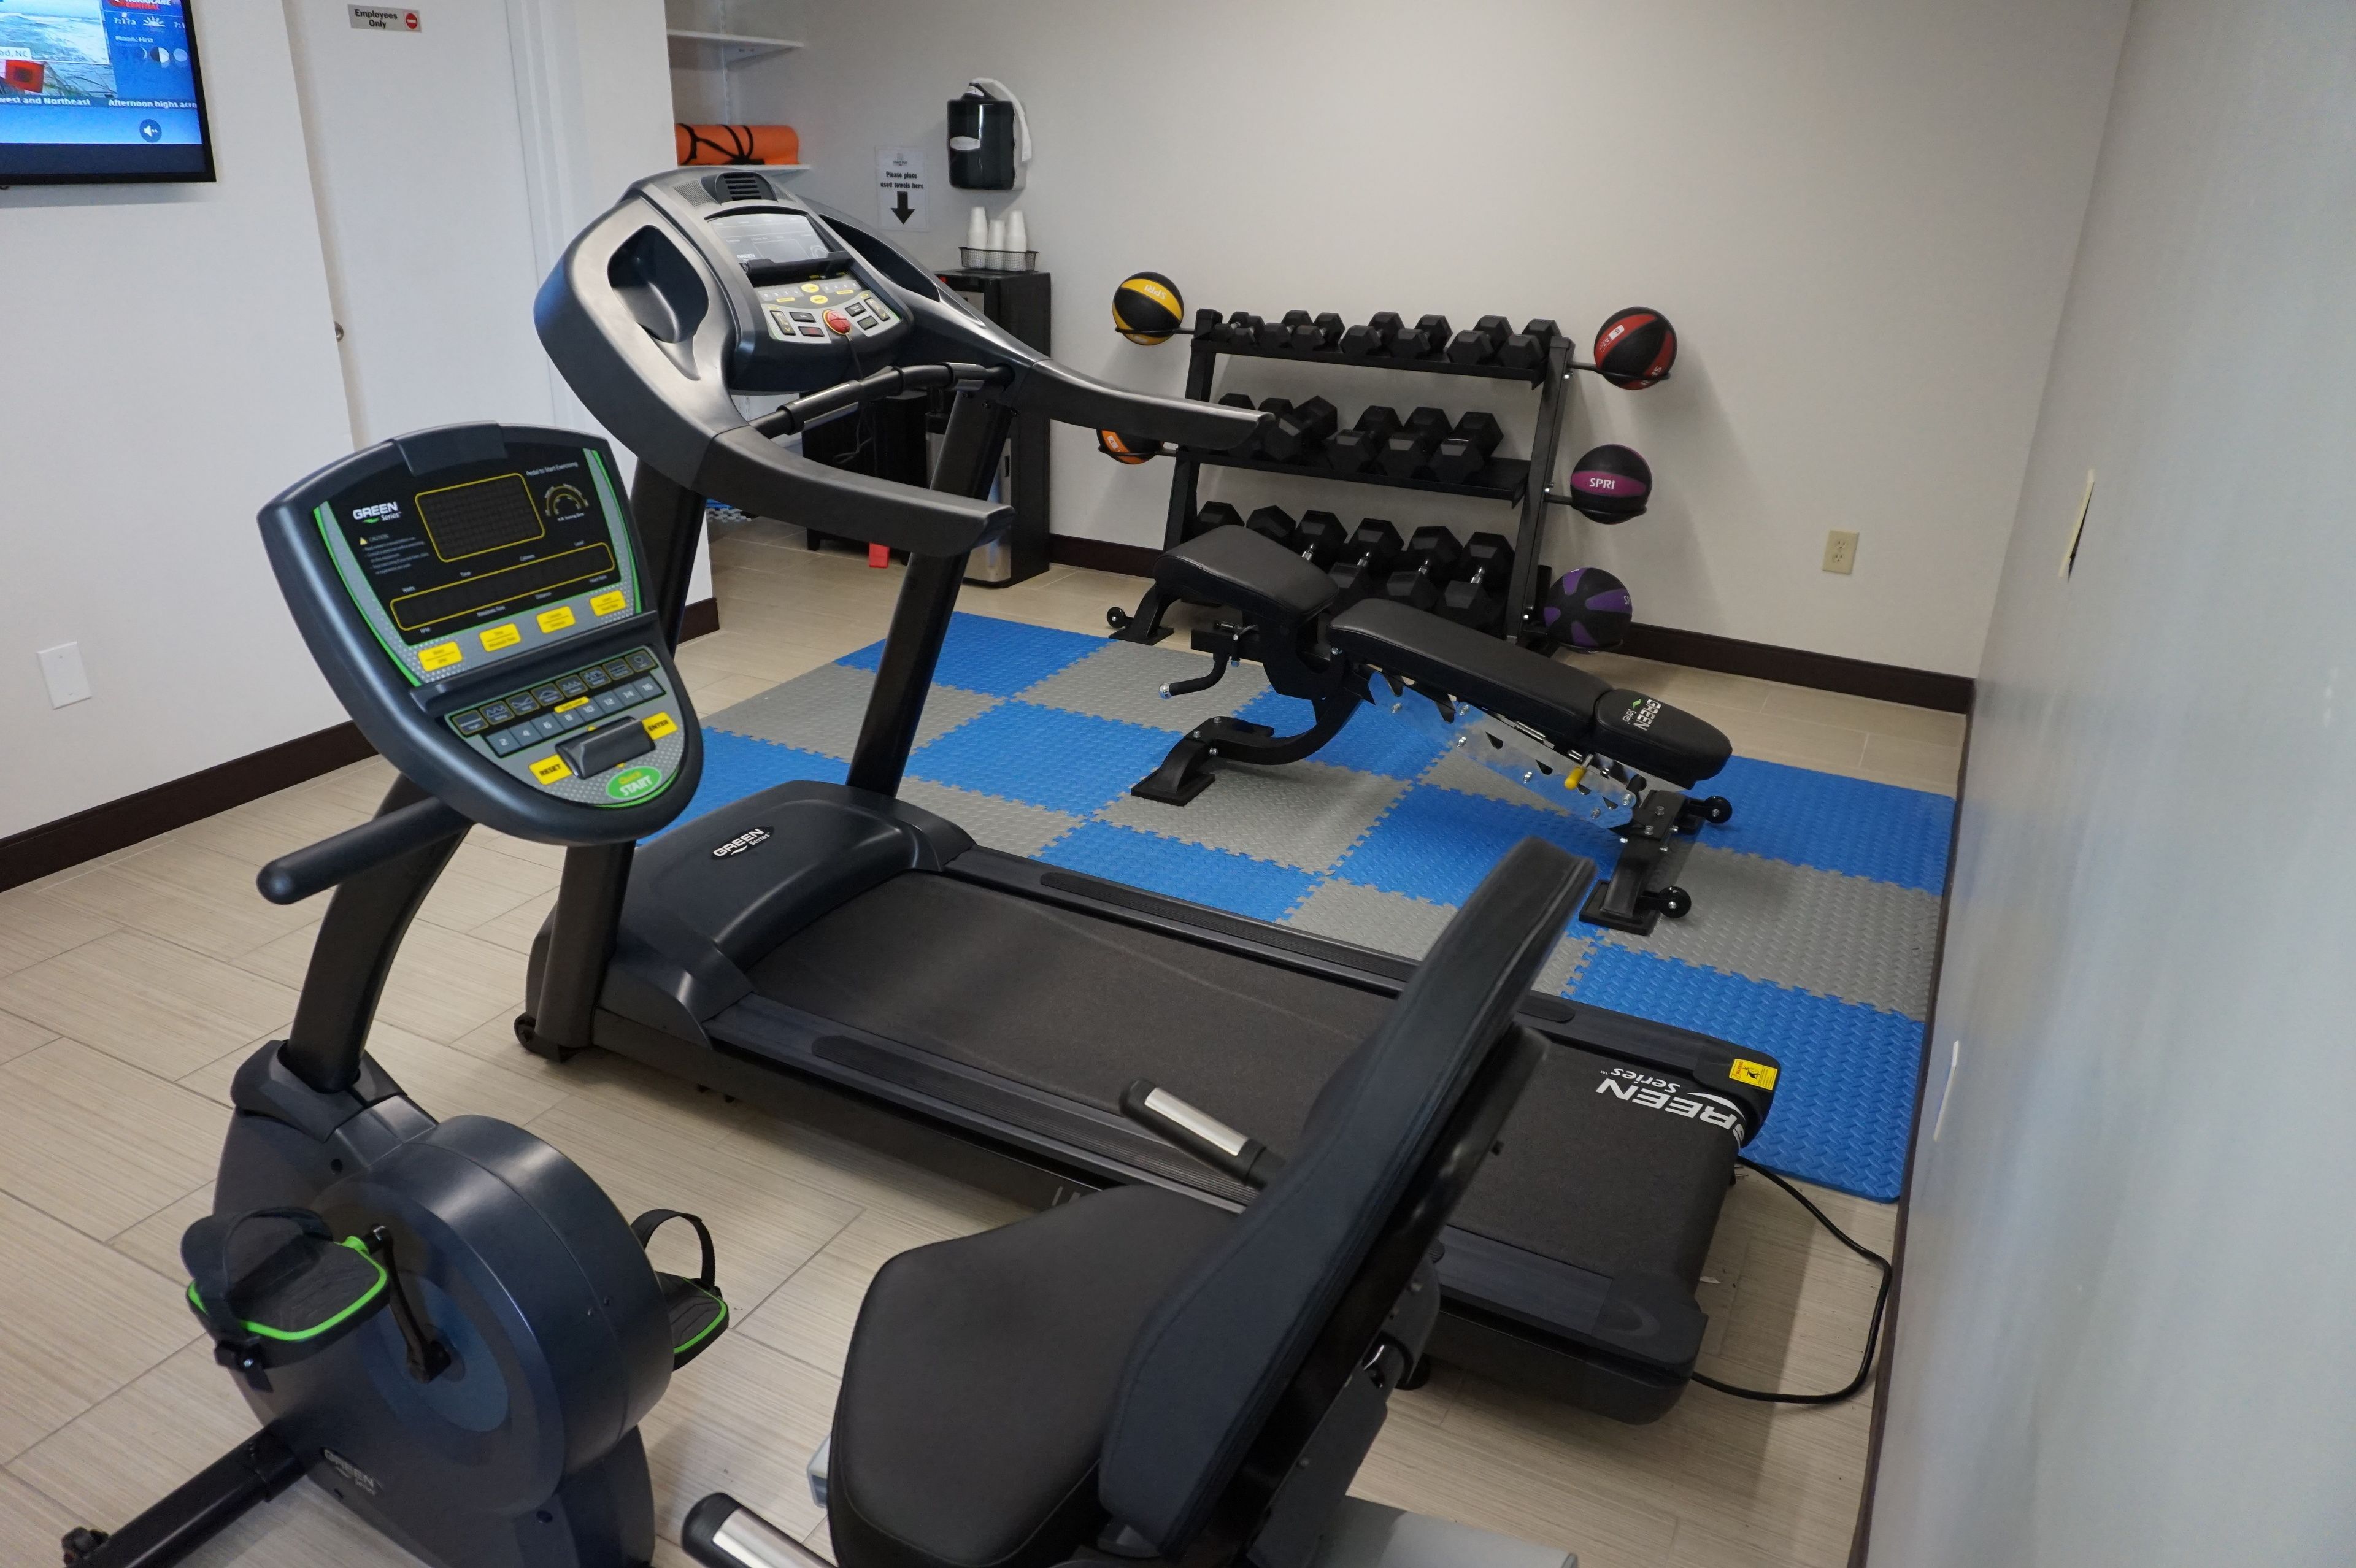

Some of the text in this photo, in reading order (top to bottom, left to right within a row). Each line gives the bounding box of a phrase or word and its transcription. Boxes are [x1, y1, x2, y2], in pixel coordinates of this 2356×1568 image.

[355, 9, 398, 19] Employees
[369, 19, 387, 29] Only
[43, 97, 90, 106] Northeast
[1589, 478, 1615, 490] SPRI
[353, 501, 399, 520] GREEN
[380, 512, 401, 521] Series
[1622, 709, 1636, 723] Series
[1633, 699, 1661, 731] GREEN
[647, 719, 669, 731] ENTER
[539, 763, 561, 777] RESET
[619, 775, 653, 796] START
[713, 828, 764, 856] GREEN
[749, 832, 771, 845] Series
[1611, 1068, 1680, 1093] Series
